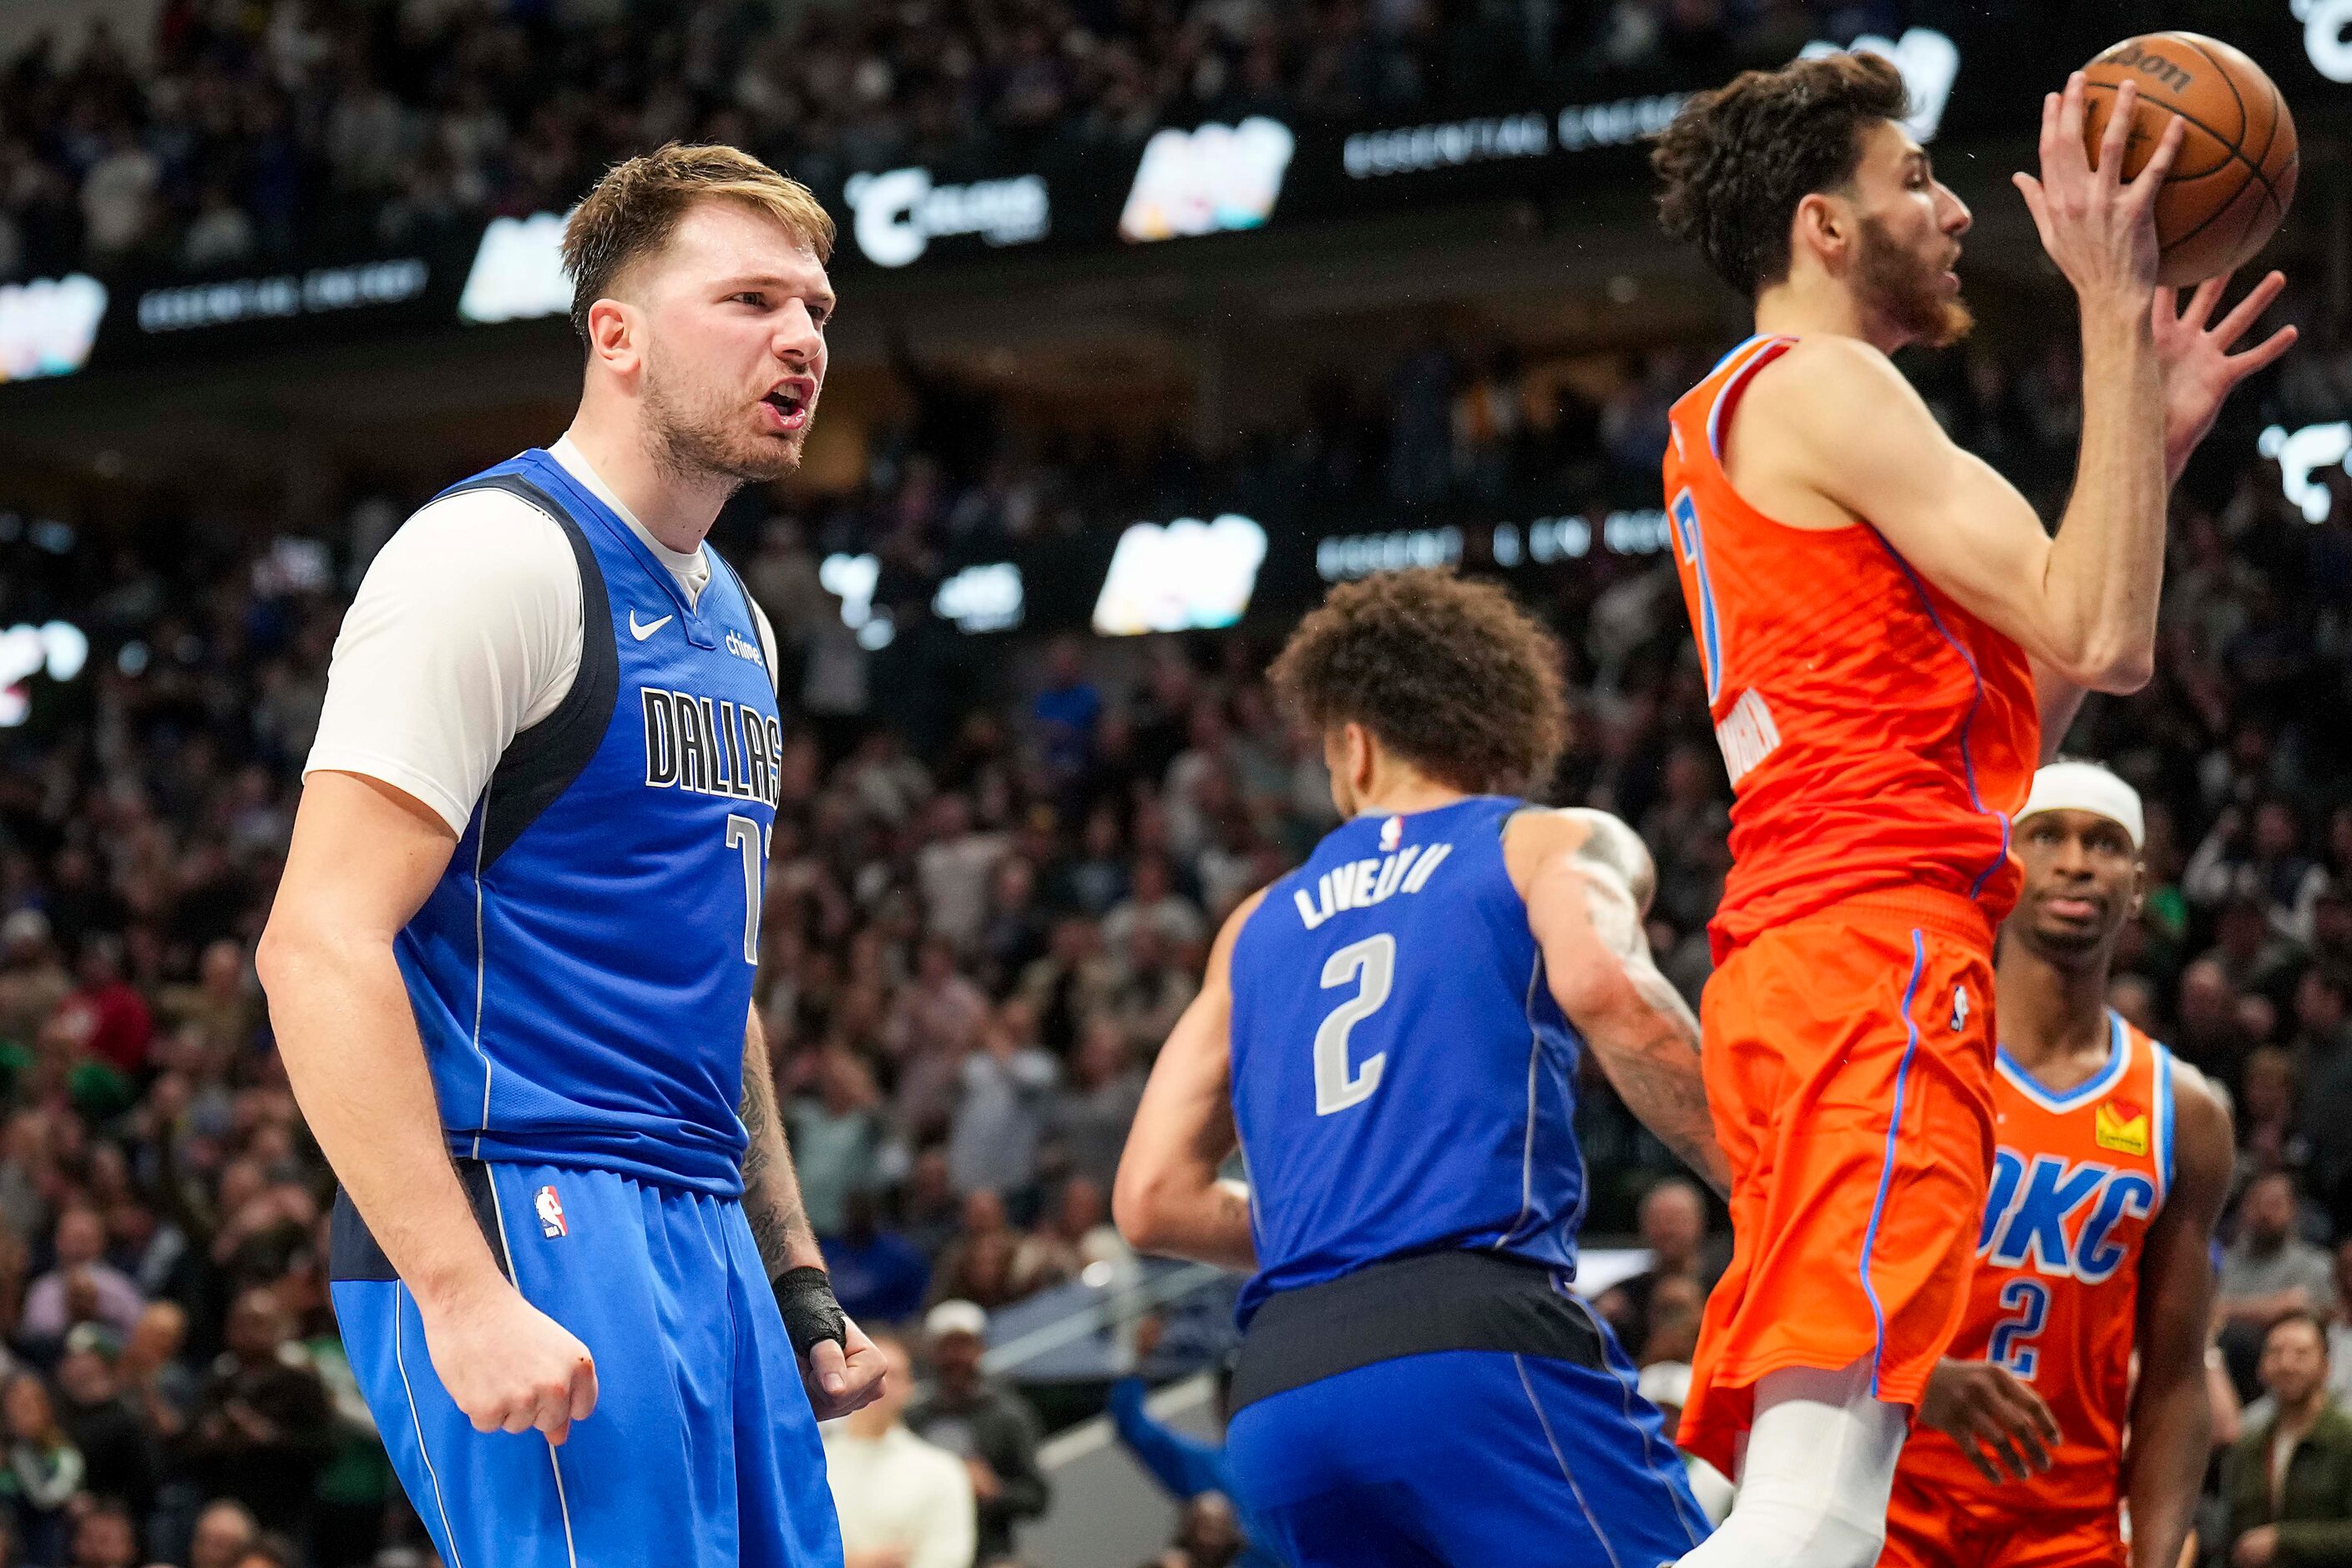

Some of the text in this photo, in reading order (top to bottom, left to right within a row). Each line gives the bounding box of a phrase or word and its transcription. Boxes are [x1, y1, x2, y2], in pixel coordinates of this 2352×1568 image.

[725, 629, 763, 667] chime
[640, 686, 782, 811] DALLAS
[1293, 842, 1454, 931] LIVELY II
[1313, 932, 1397, 1117] 2
[1988, 1277, 2052, 1382] 2
